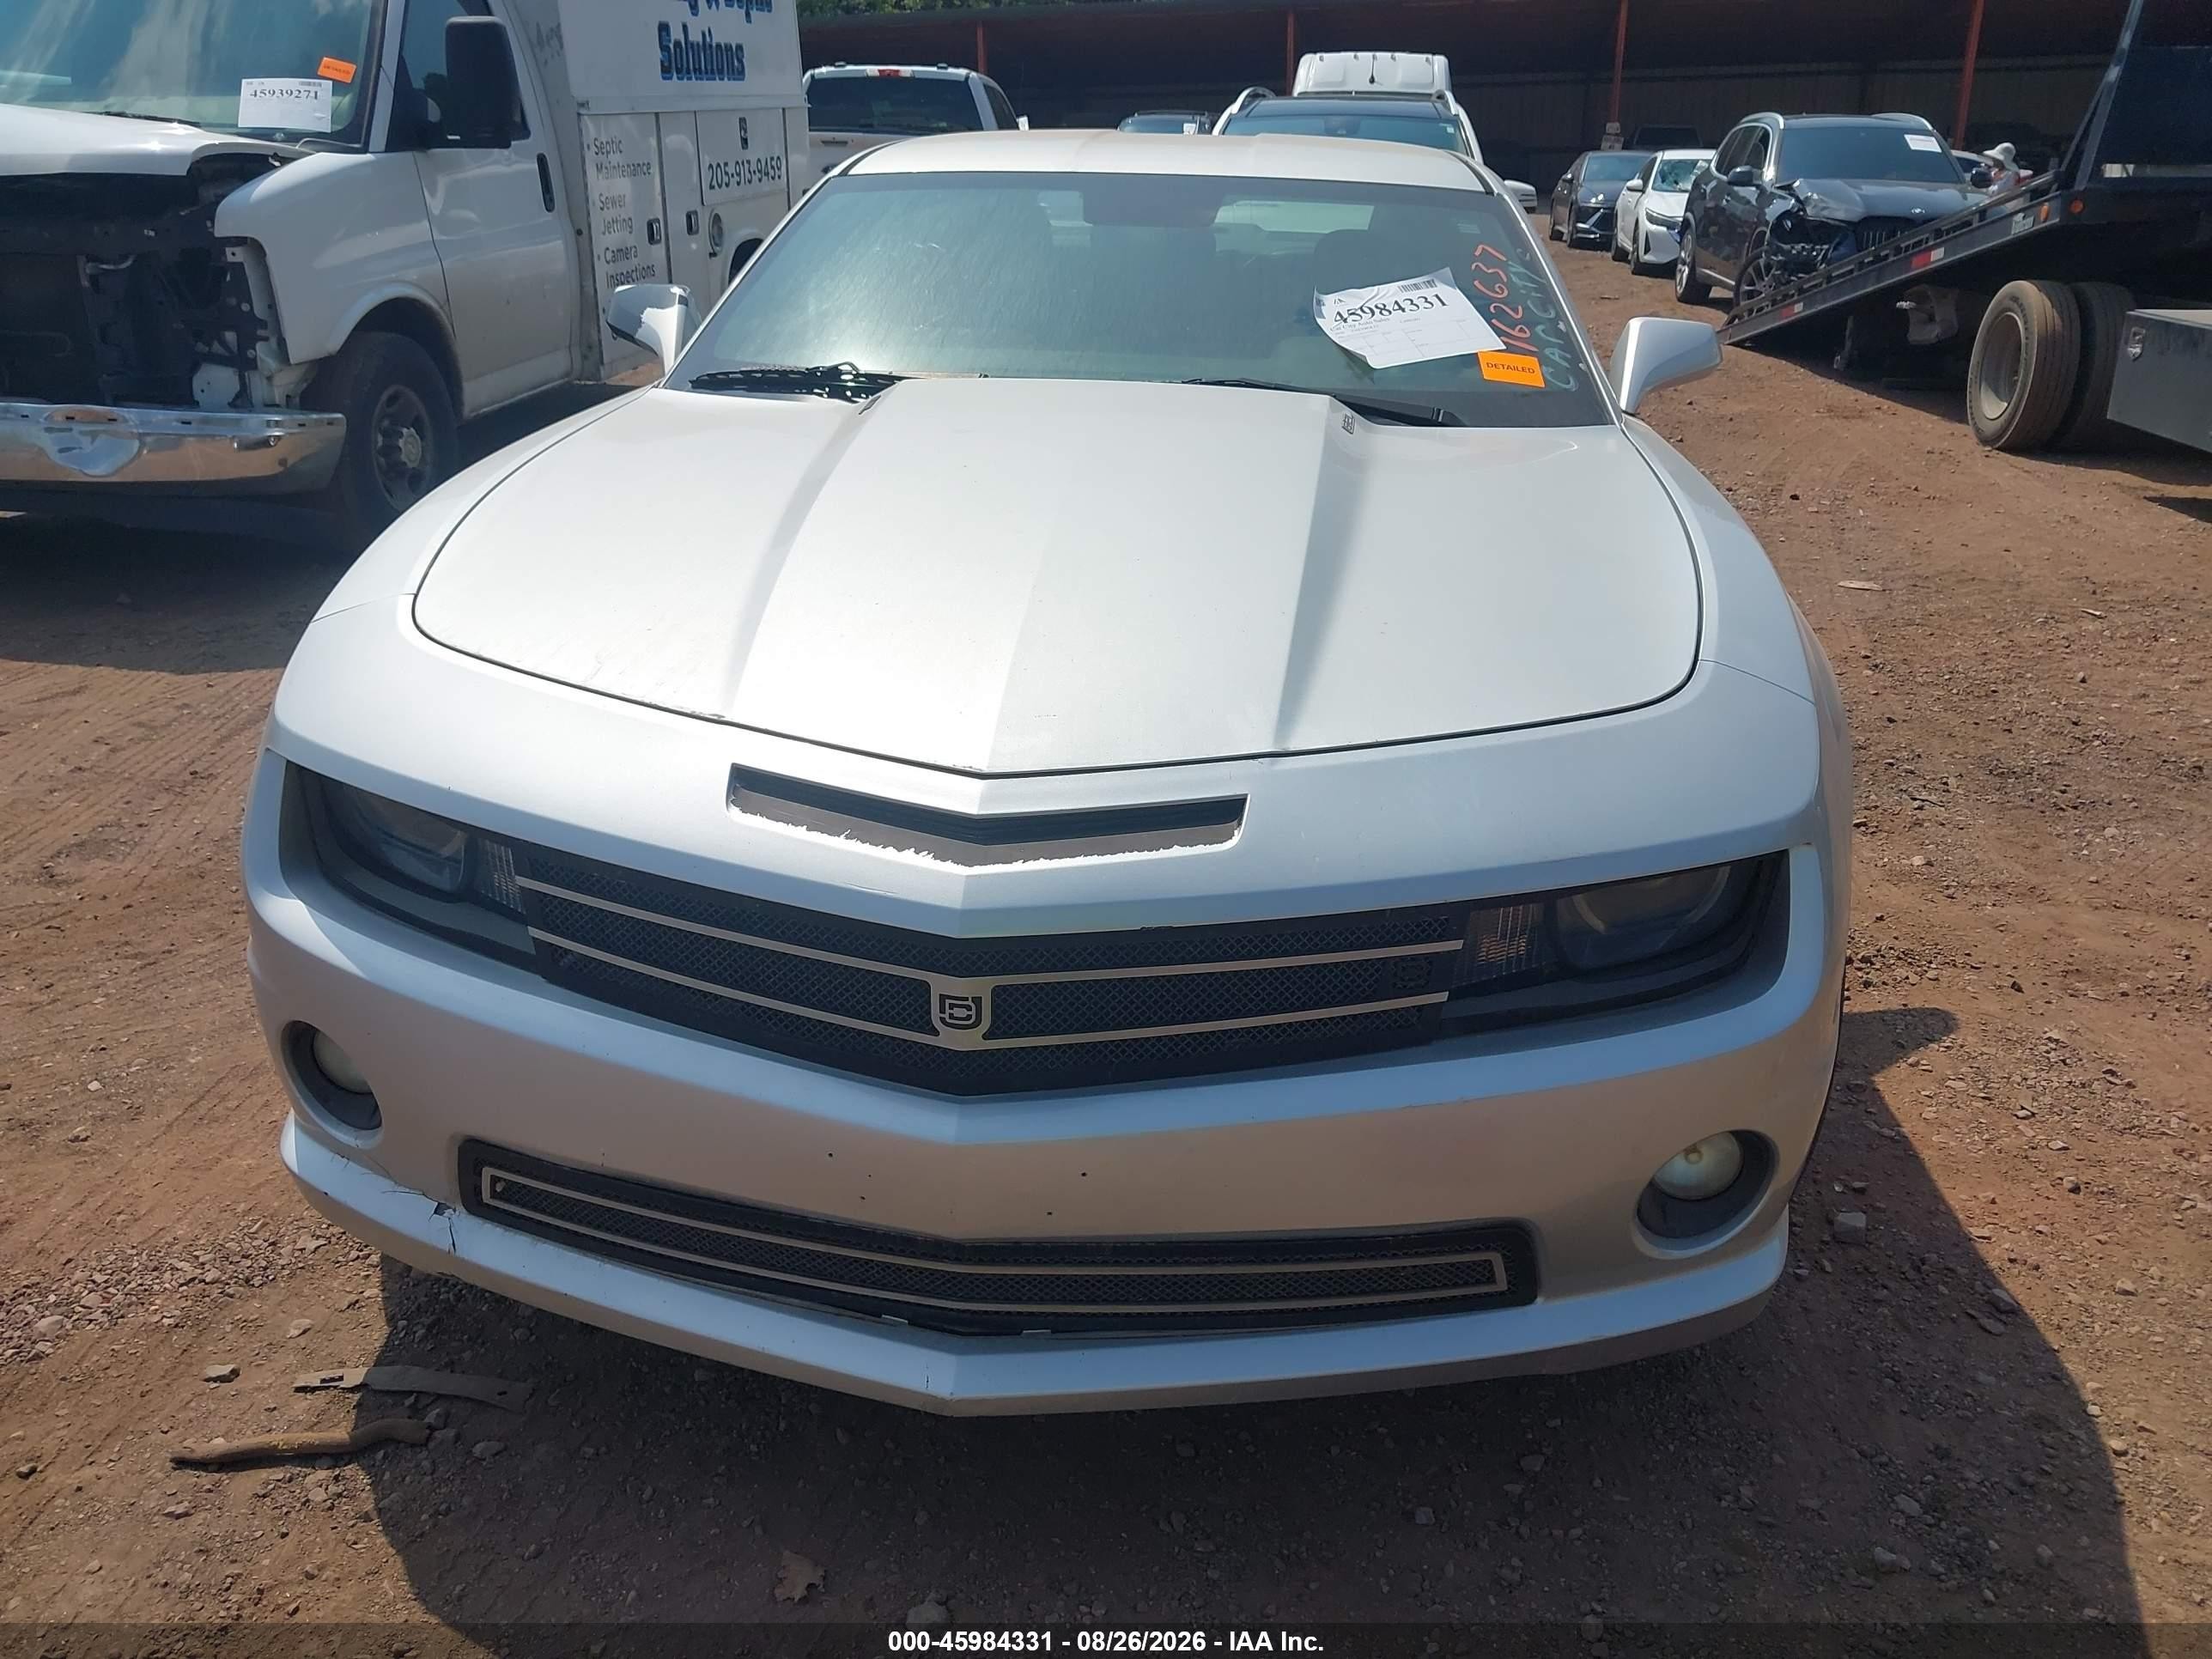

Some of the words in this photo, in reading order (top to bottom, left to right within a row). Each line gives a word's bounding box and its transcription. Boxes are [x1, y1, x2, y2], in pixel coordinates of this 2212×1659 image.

[658, 21, 745, 81] Solutions
[250, 88, 319, 100] 45939271
[593, 136, 623, 158] Septic
[596, 161, 652, 181] Maintenance
[708, 155, 782, 190] 205-913-9459
[599, 192, 626, 211] Sewer
[602, 215, 634, 235] Jetting
[604, 245, 638, 264] Camera
[606, 264, 656, 289] Inspections
[1334, 293, 1450, 324] 45984331
[1486, 362, 1535, 374] DETAILED
